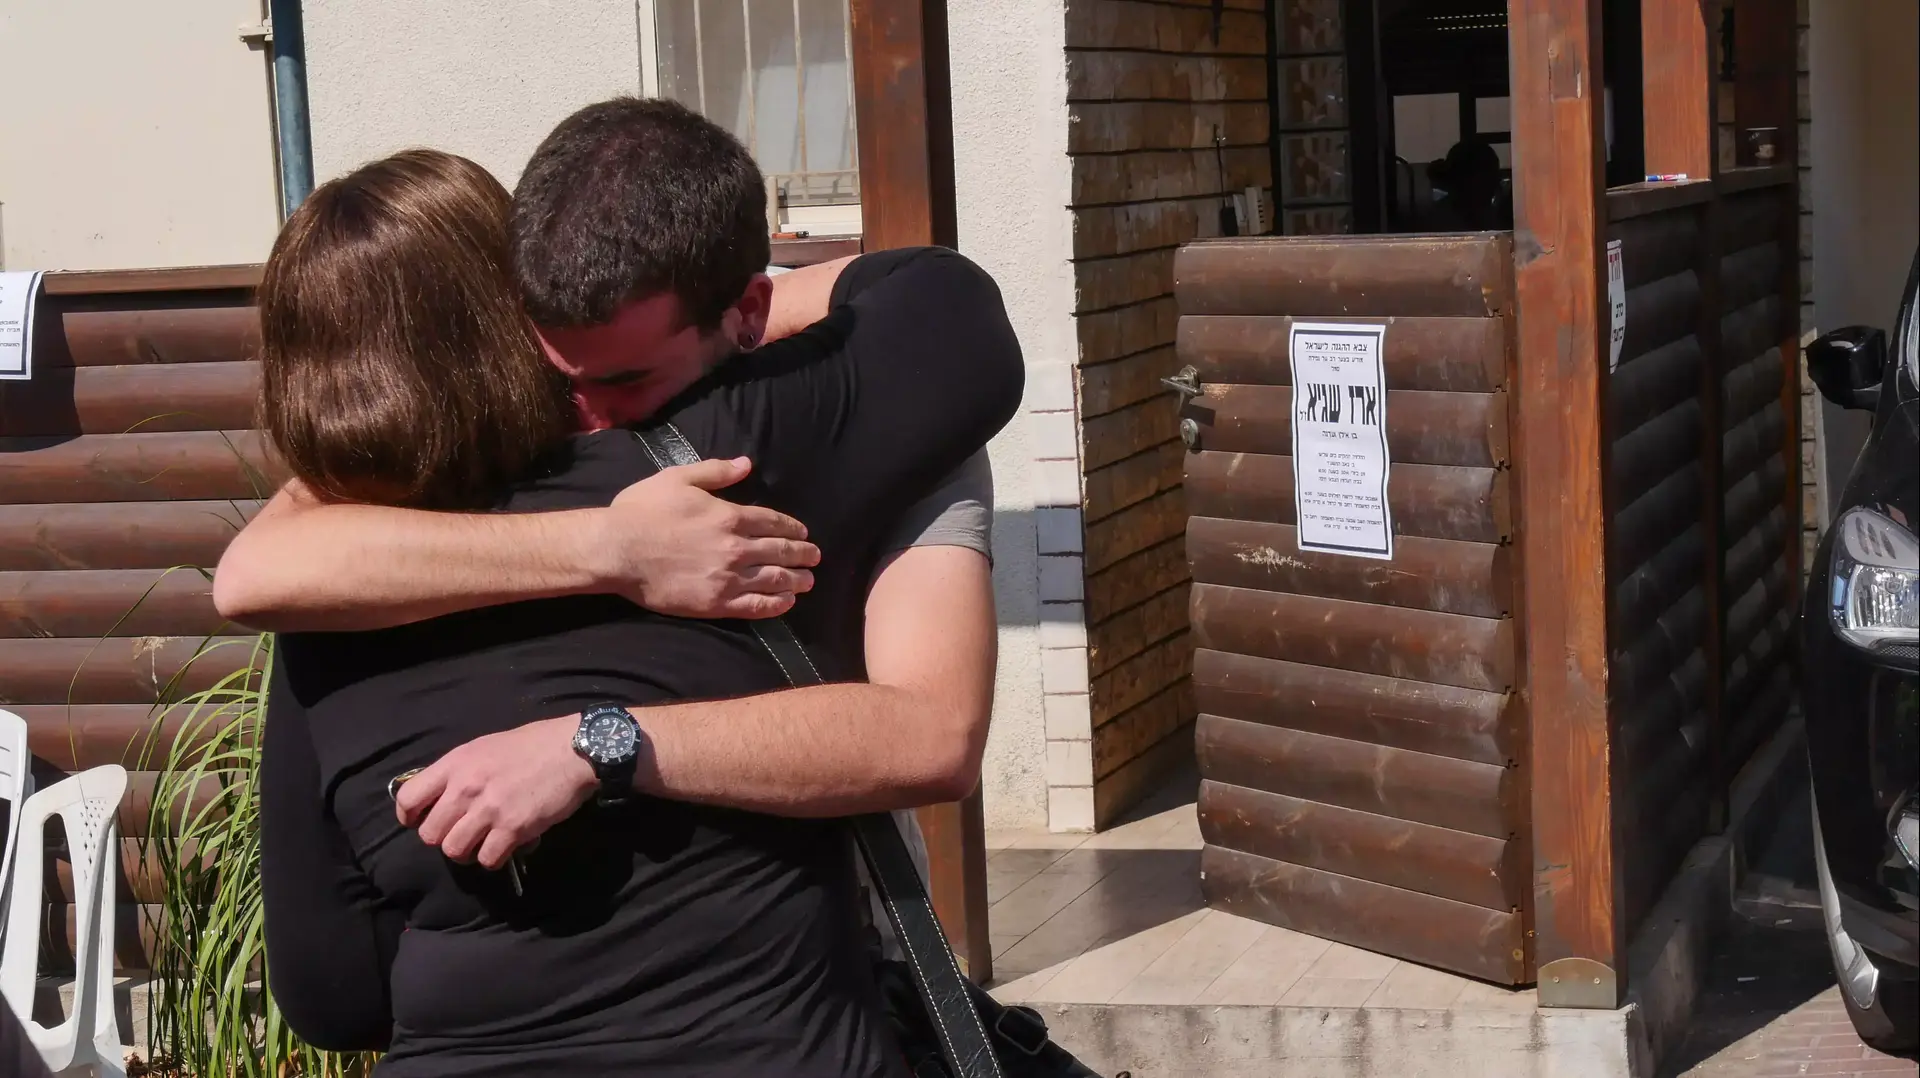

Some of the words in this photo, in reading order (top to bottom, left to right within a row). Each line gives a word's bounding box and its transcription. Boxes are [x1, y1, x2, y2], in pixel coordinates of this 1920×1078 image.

[1305, 341, 1329, 350] לישראל
[1331, 342, 1351, 351] ההגנה
[1353, 343, 1368, 352] צבא
[1307, 383, 1341, 423] שגיא
[1348, 385, 1377, 426] ארז
